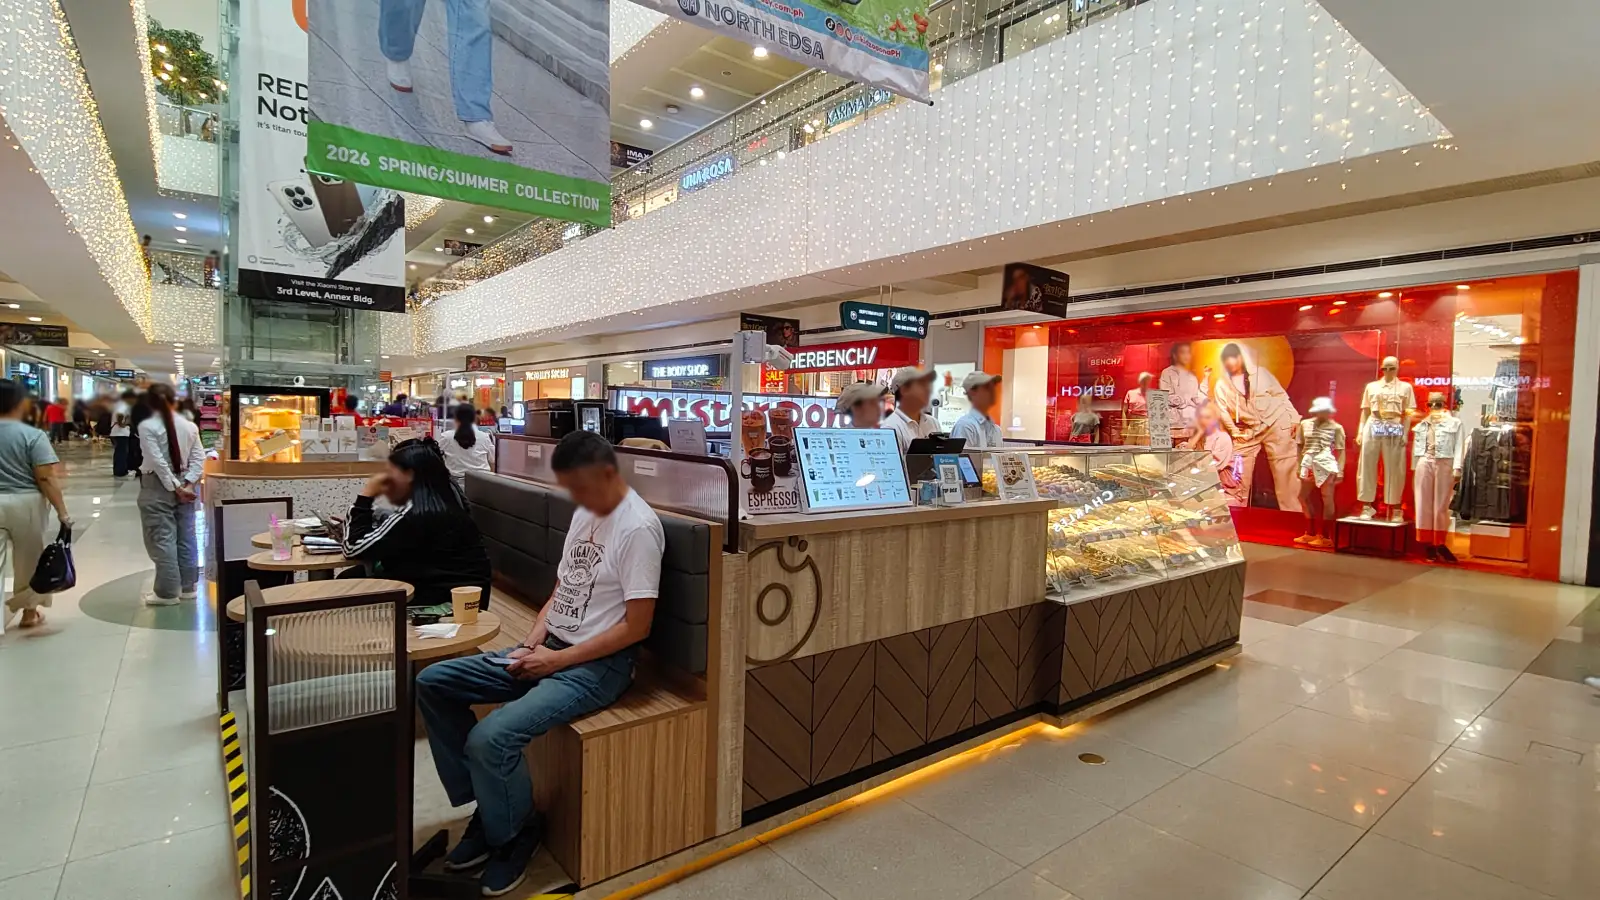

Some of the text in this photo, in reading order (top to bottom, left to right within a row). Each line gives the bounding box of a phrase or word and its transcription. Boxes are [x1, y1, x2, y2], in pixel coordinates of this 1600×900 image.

[704, 0, 825, 60] NORTH EDSA
[257, 121, 271, 130] It's
[272, 124, 292, 135] titan
[326, 144, 601, 212] 2026 SPRING/SUMMER COLLECTION
[290, 278, 305, 287] Visit
[305, 280, 316, 288] the
[317, 281, 337, 290] Xiaomi
[338, 283, 354, 292] Store
[277, 286, 375, 304] 3rd Level, Annex Bldg.
[652, 367, 667, 378] THE
[667, 366, 687, 377] BODY
[765, 371, 784, 381] SALE
[748, 491, 798, 507] ESPRESSO
